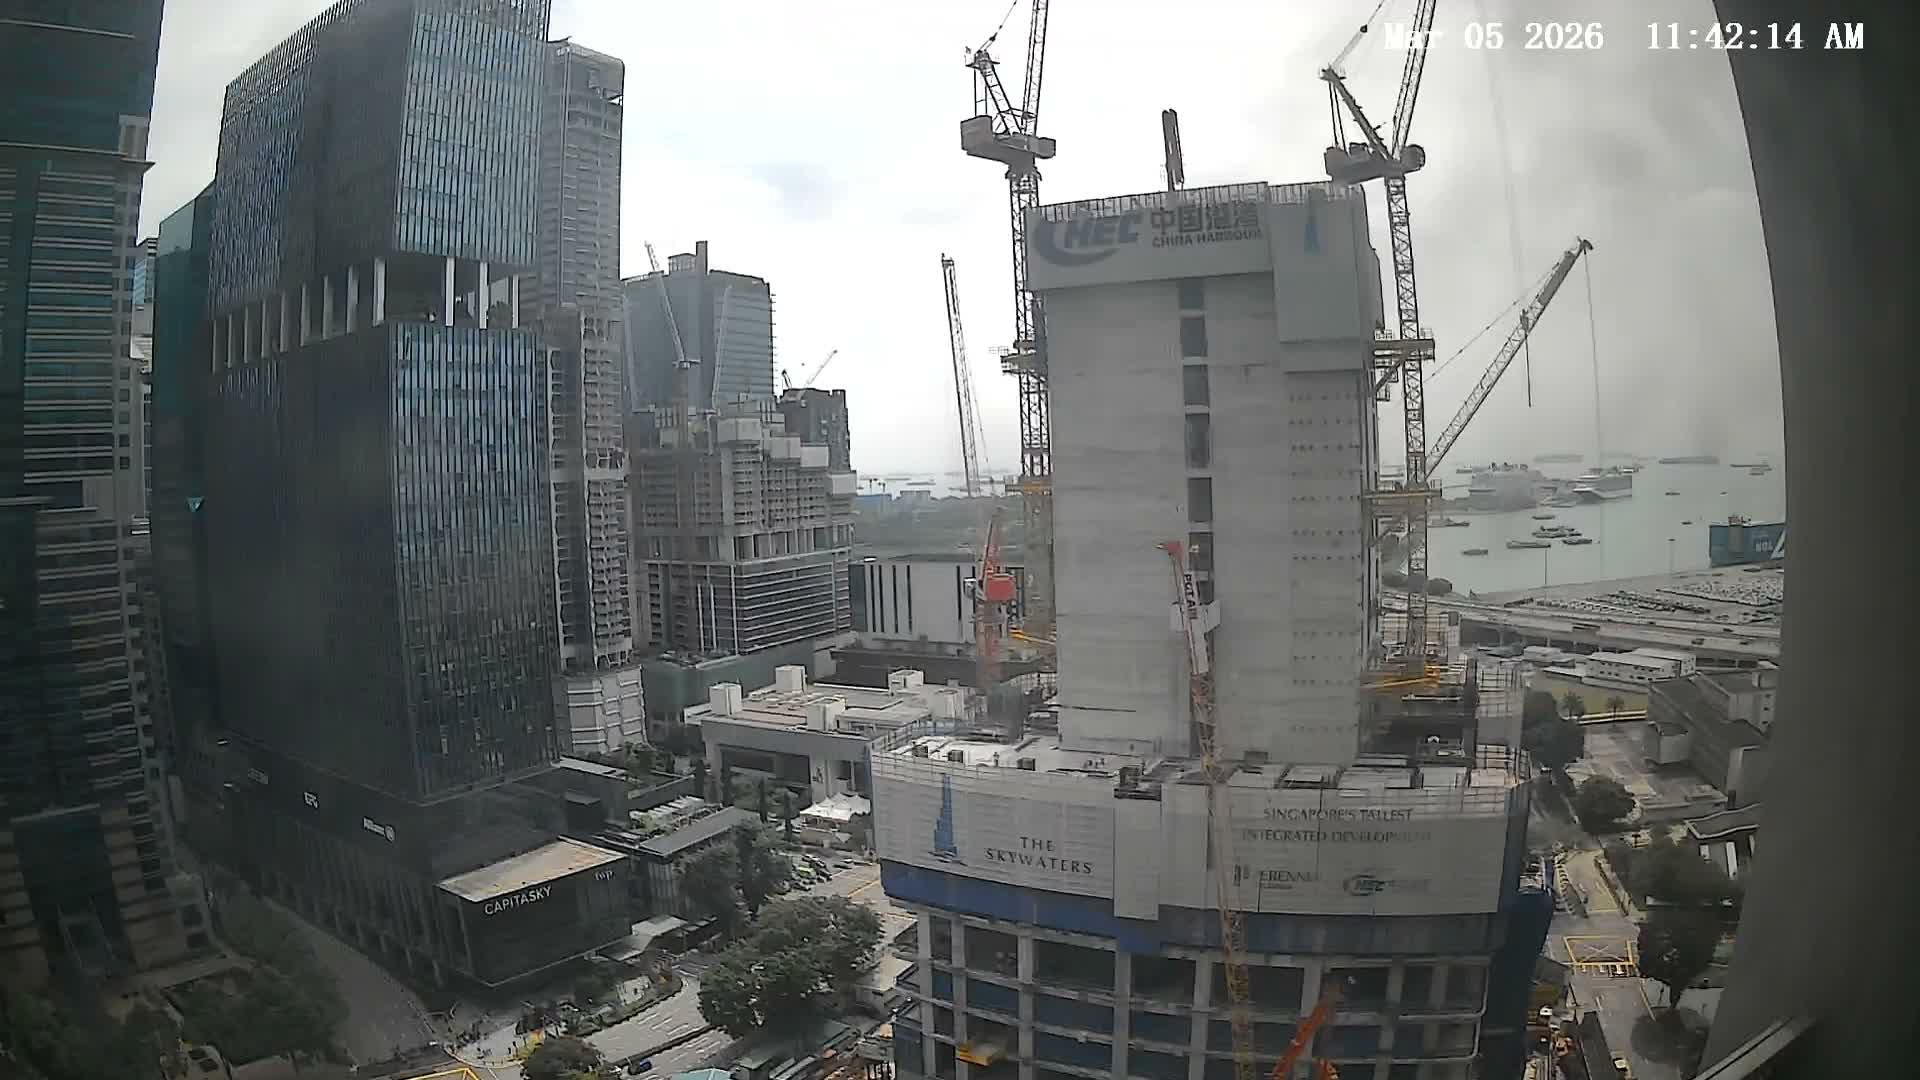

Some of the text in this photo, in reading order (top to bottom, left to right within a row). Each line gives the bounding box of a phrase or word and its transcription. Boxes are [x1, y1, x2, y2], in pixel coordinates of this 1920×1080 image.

[1152, 233, 1193, 248] CHINA
[1264, 807, 1413, 822] SINGAPORE'S TALLEST
[1020, 836, 1056, 852] THE
[1332, 830, 1432, 844] DEVELOP
[985, 848, 1094, 875] SKYWATERS
[484, 885, 553, 916] CAPITASKY
